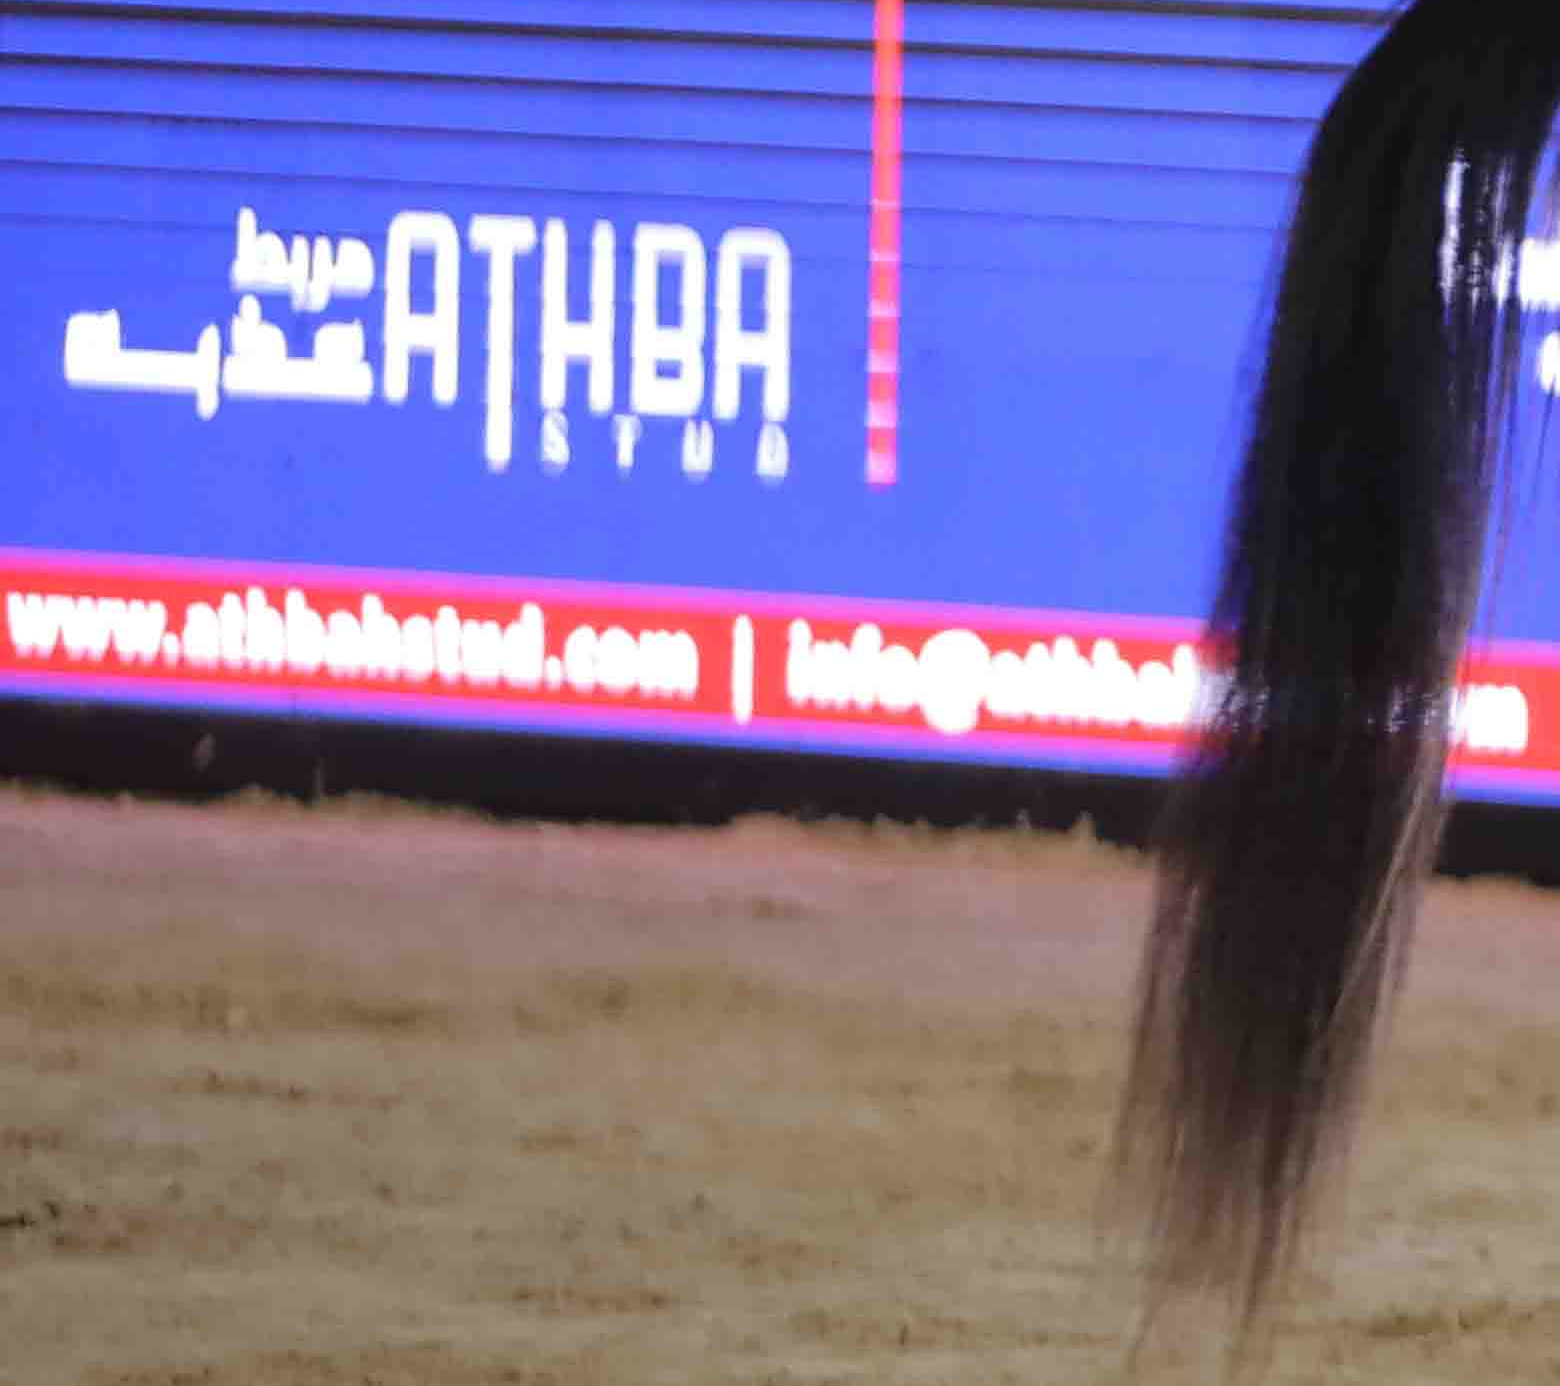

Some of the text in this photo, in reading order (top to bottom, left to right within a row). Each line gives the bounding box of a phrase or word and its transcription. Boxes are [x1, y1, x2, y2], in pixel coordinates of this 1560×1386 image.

[382, 210, 793, 473] ATHBA
[540, 412, 792, 480] STUD
[6, 585, 700, 699] www.athbahstud.com
